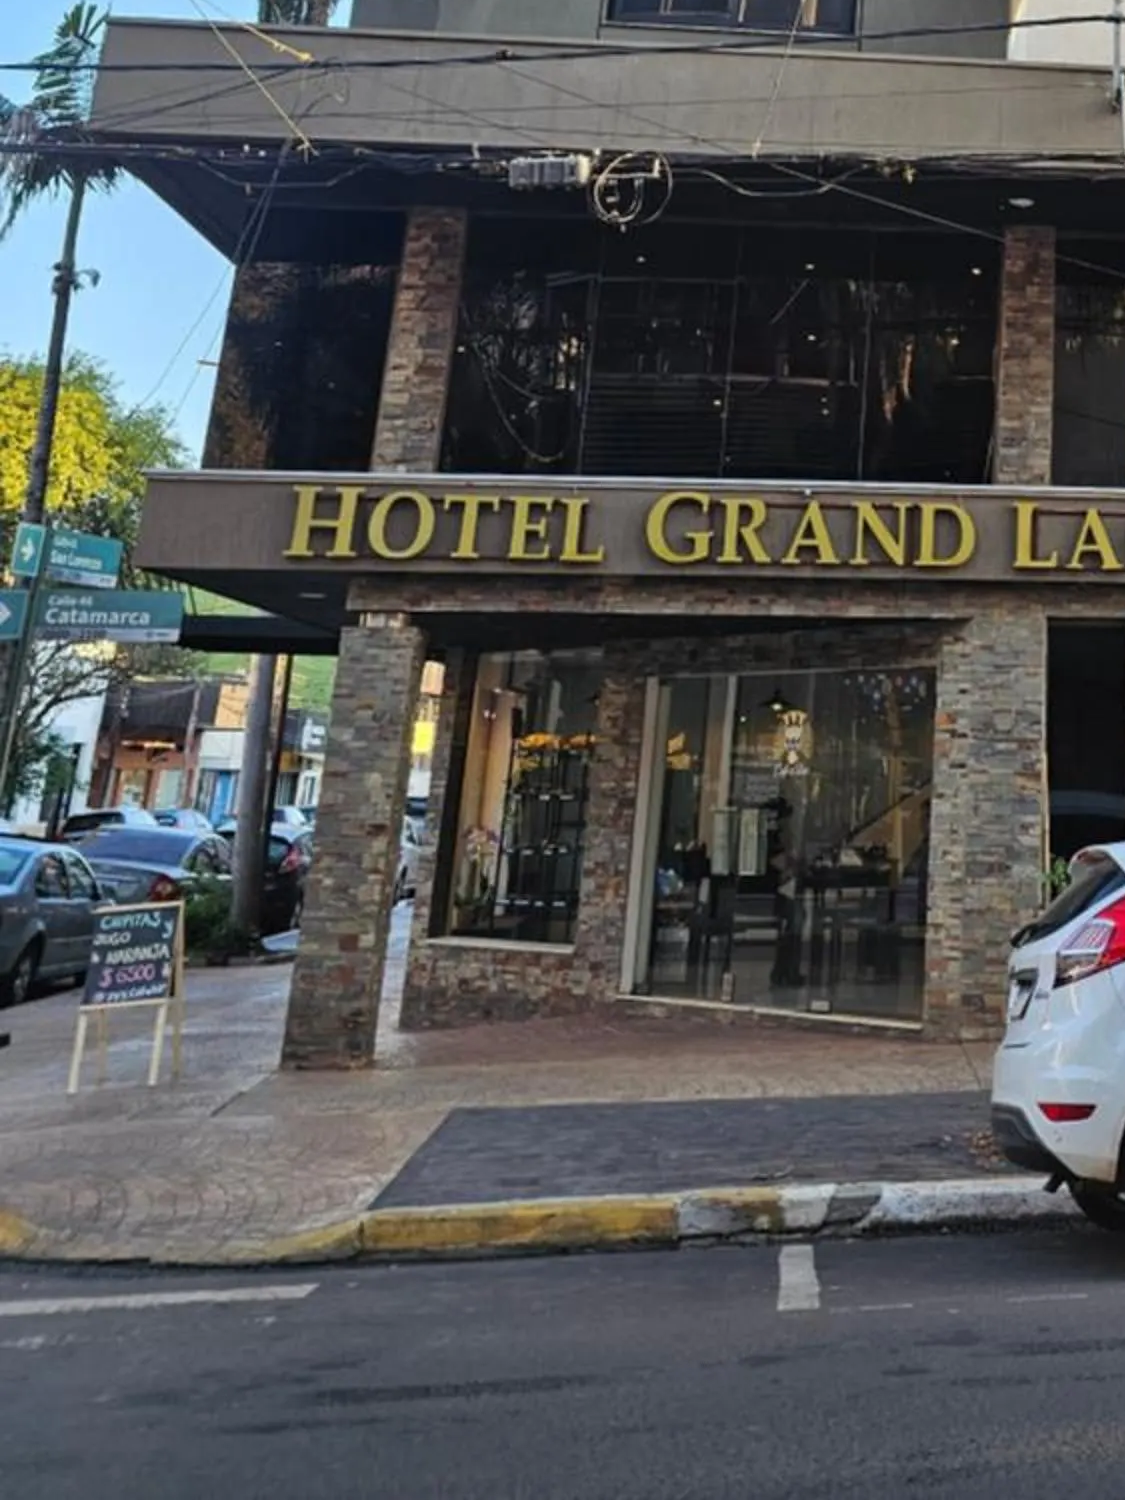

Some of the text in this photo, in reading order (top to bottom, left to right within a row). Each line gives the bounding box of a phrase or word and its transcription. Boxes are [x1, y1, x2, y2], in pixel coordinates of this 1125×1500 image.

[283, 484, 605, 562] HOTEL
[645, 491, 976, 567] GRAND
[45, 607, 151, 625] Catamarca
